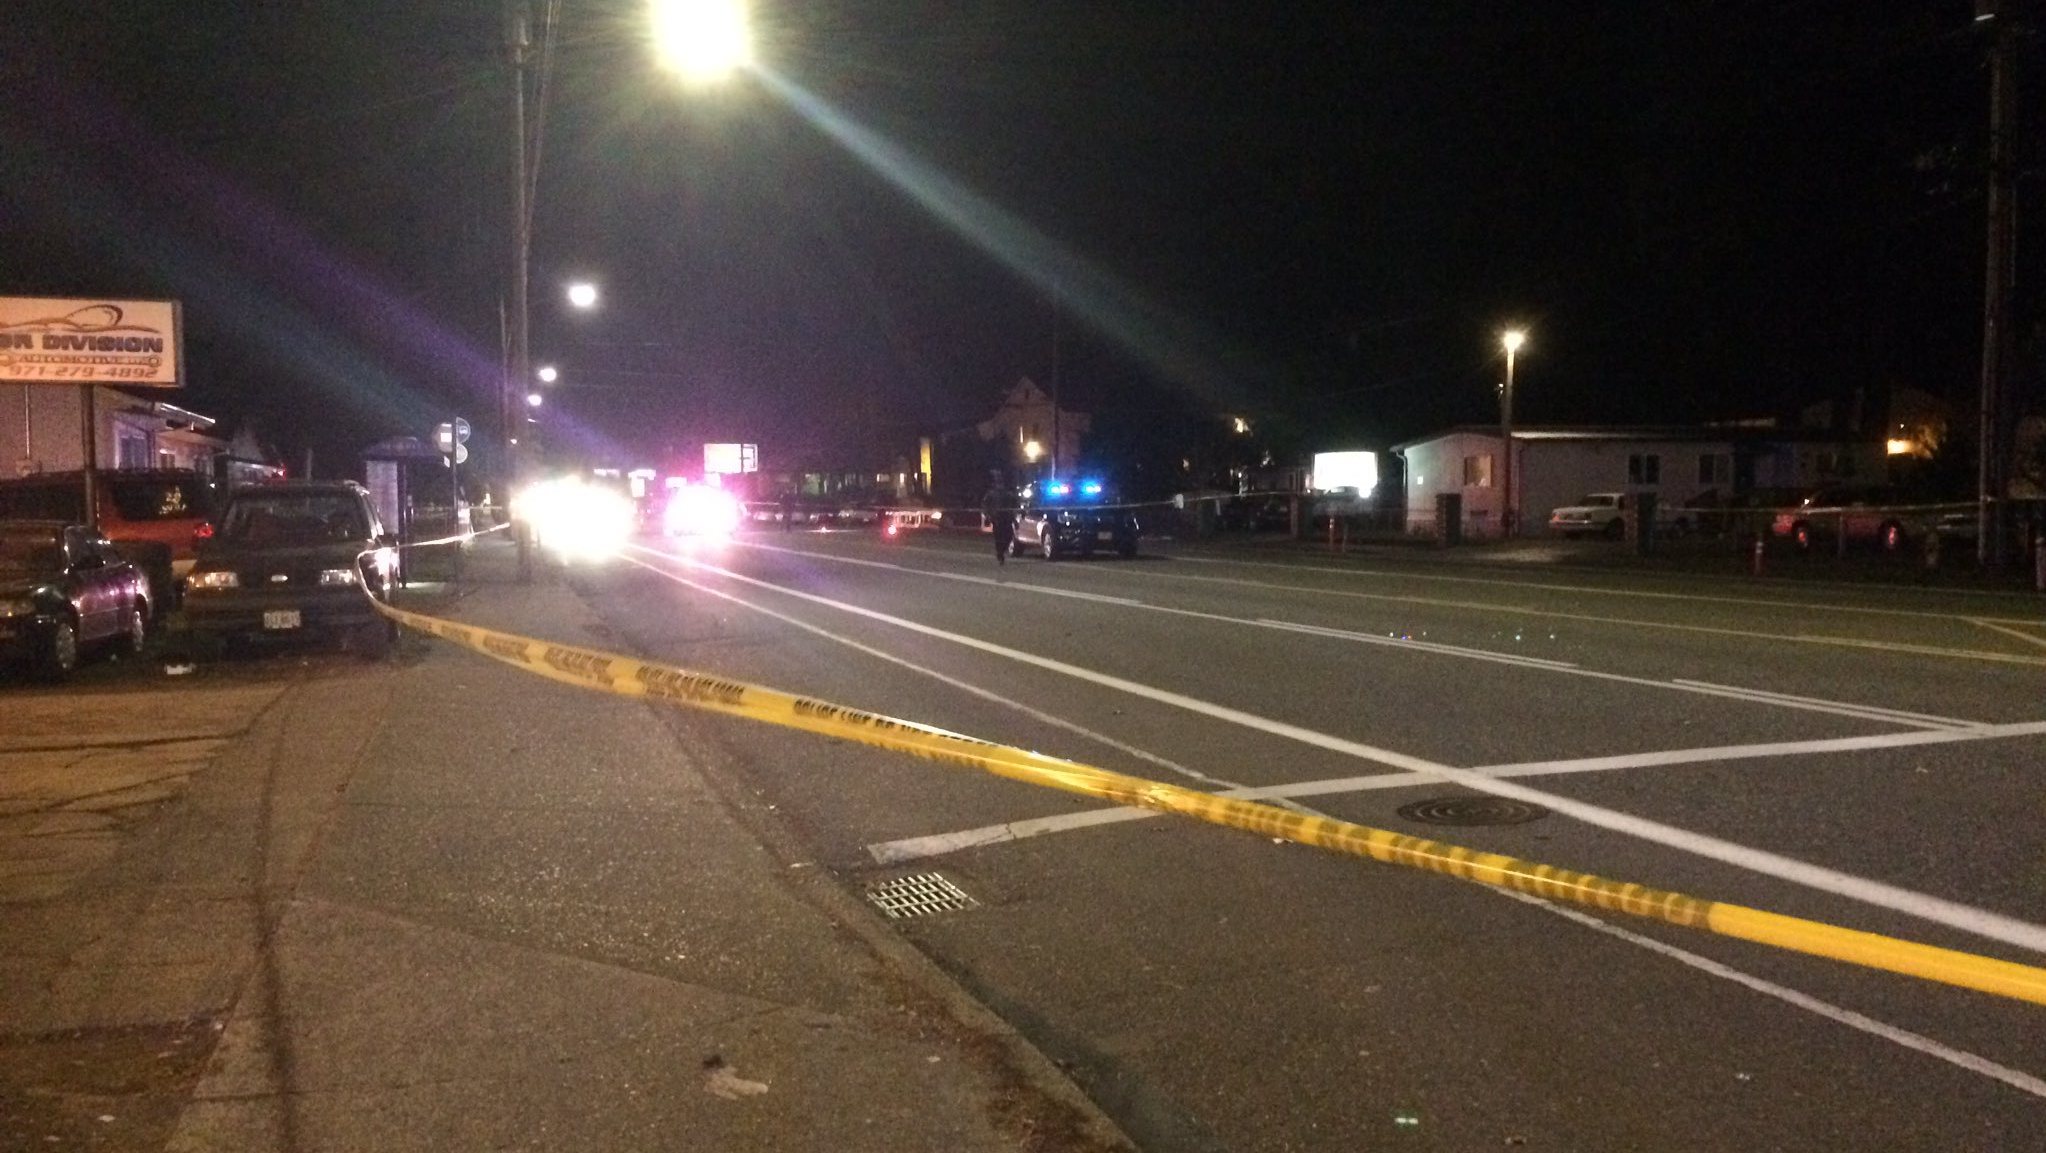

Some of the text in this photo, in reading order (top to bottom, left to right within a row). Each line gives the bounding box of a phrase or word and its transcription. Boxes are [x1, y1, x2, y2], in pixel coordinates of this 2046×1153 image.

[42, 334, 163, 352] DIVISION
[19, 354, 122, 365] AUTOMOTIVE
[10, 366, 158, 377] 971-279-4892
